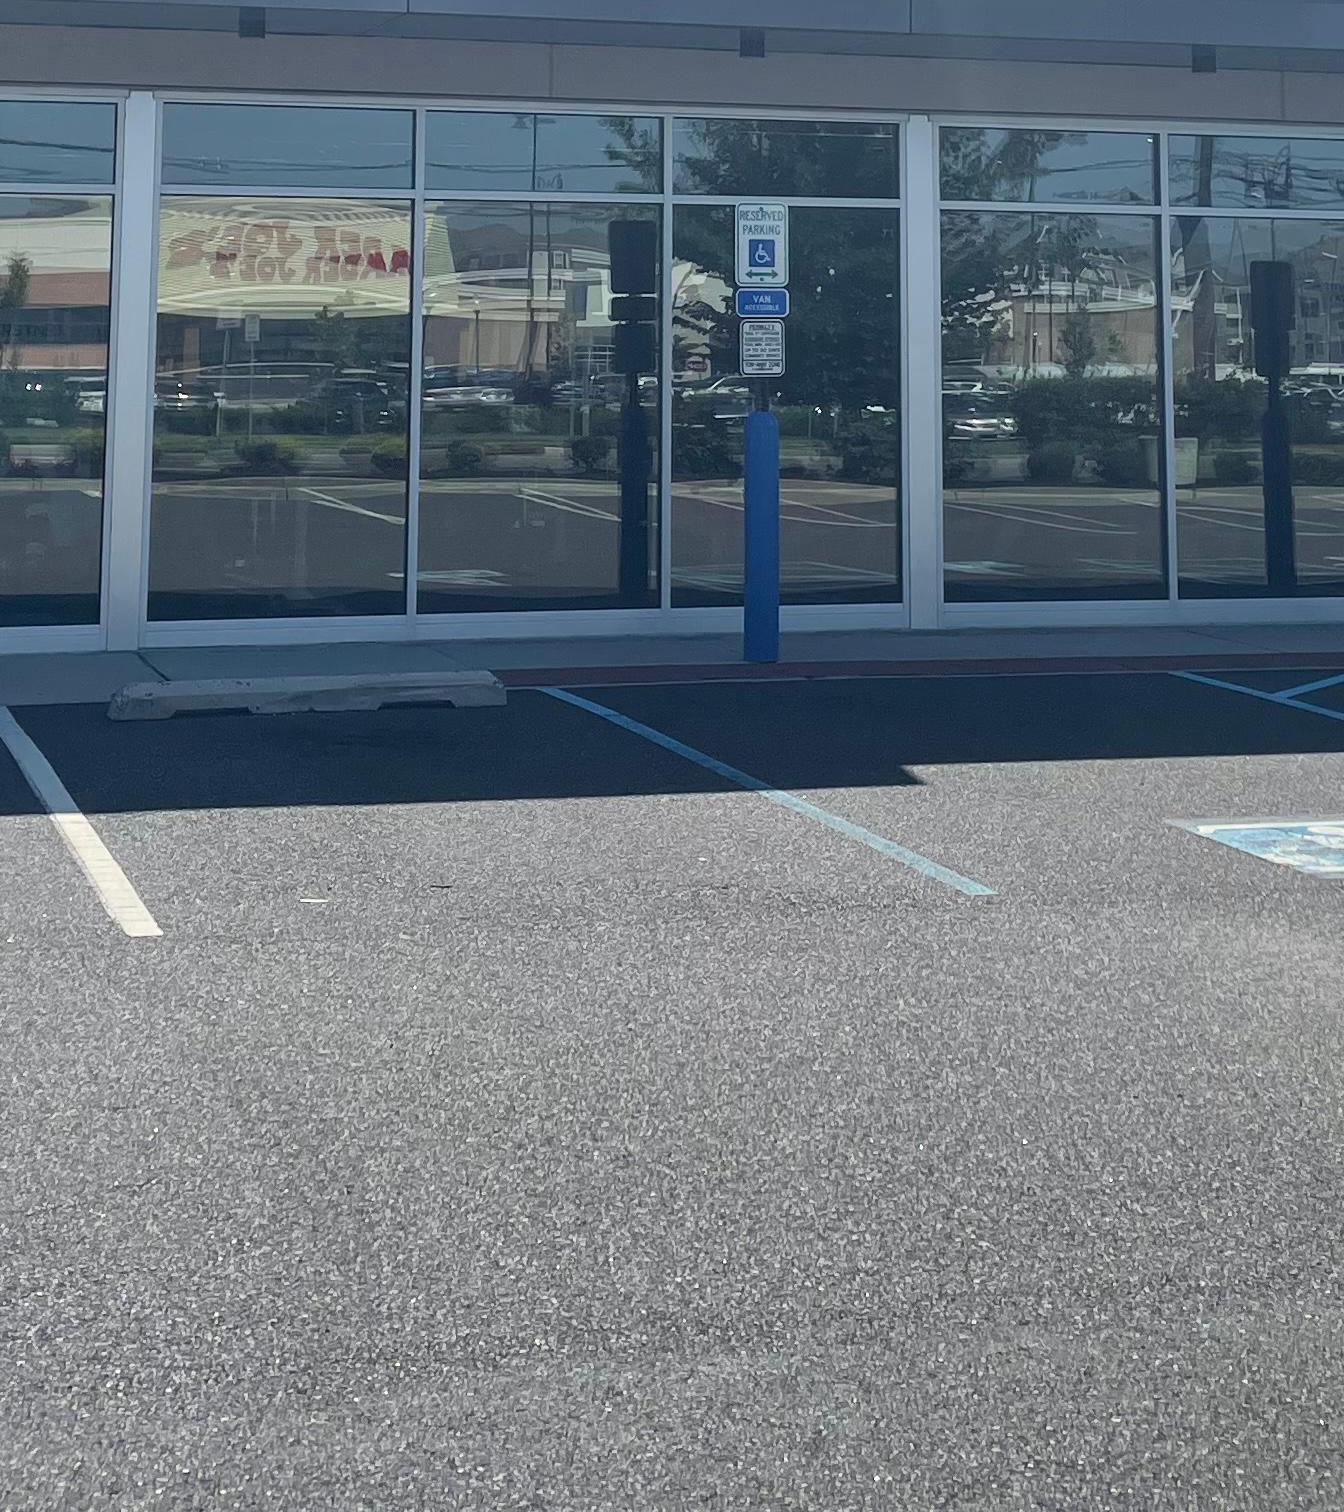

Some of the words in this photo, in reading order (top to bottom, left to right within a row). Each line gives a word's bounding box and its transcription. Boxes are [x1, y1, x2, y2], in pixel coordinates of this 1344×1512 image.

[739, 210, 783, 221] RESERVED
[742, 224, 781, 235] PARKING
[752, 295, 771, 303] VAN
